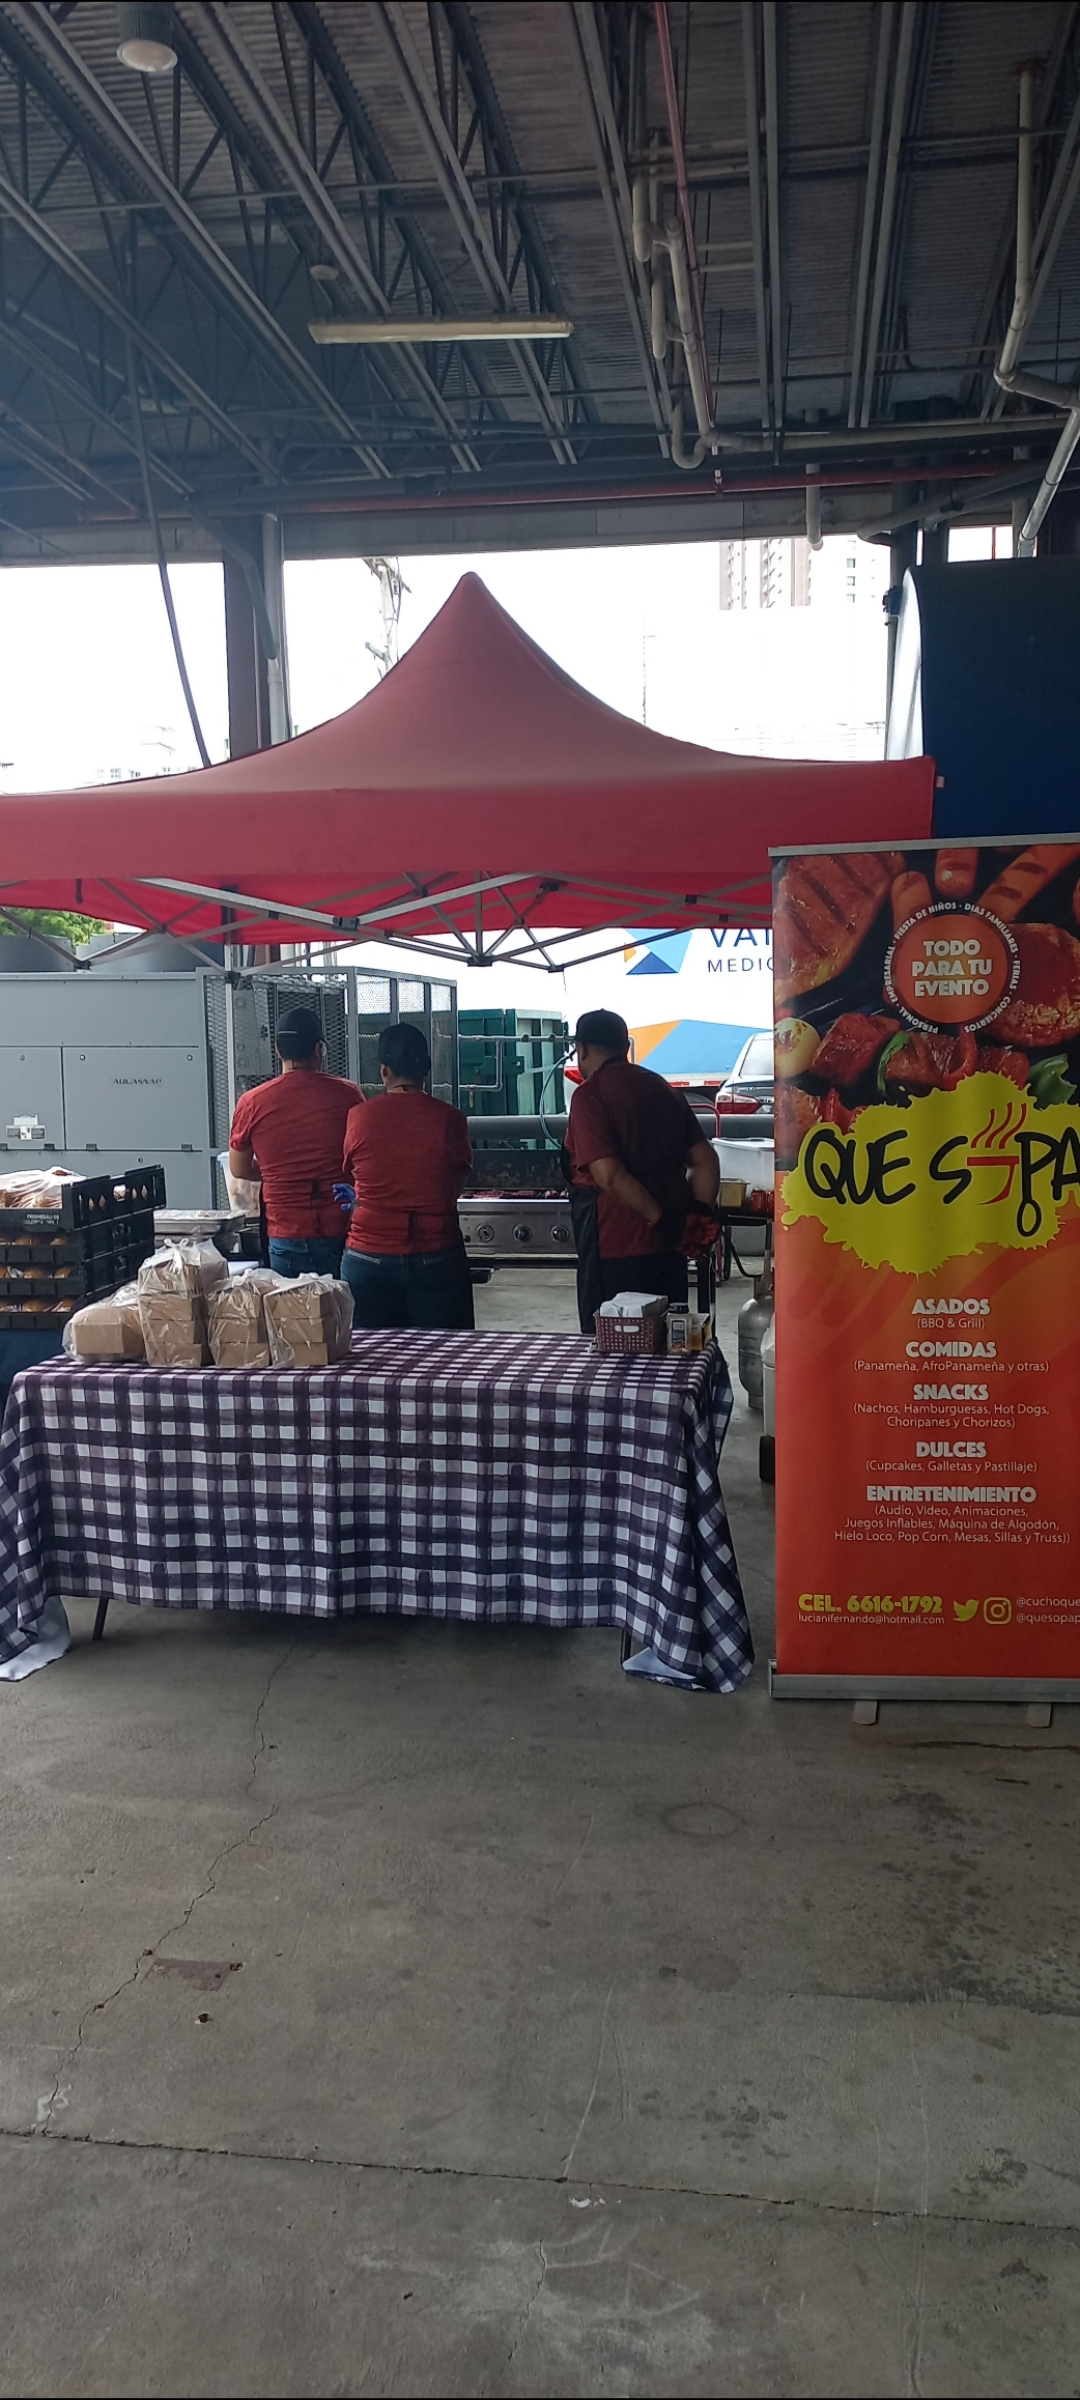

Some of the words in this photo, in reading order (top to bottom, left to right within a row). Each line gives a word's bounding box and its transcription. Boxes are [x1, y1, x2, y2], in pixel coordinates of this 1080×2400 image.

[916, 909, 927, 919] DE
[928, 901, 956, 914] NIÑOS
[964, 903, 985, 915] DIAS
[894, 917, 916, 940] FIESTA
[984, 911, 1019, 953] FAMILIARES
[923, 939, 981, 956] TODO
[884, 946, 898, 1003] EMPRESARIAL
[912, 960, 965, 977] PARA
[968, 959, 992, 975] TU
[1009, 960, 1020, 990] FERIAS
[914, 979, 989, 997] EVENTO
[899, 1006, 938, 1033] PERSONAL
[964, 996, 1011, 1033] CONCIERTOS
[804, 1128, 916, 1205] QUE
[911, 1298, 991, 1315] ASADOS
[917, 1318, 944, 1329] (BBQ
[947, 1318, 955, 1328] &
[958, 1318, 985, 1329] Grill)
[906, 1341, 997, 1358] COMIDAS
[854, 1360, 919, 1372] (Panameña,
[922, 1360, 1005, 1371] AfroPanameña
[1007, 1363, 1014, 1373] y
[1017, 1361, 1049, 1372] otras)
[913, 1384, 989, 1400] SNACKS
[853, 1402, 901, 1414] (Nachos,
[904, 1403, 991, 1416] Hamburguesas,
[994, 1403, 1015, 1414] Hot
[1017, 1403, 1050, 1416] Dogs,
[887, 1416, 950, 1429] Choripanes
[953, 1420, 960, 1429] y
[962, 1416, 1015, 1429] Chorizos)
[916, 1441, 987, 1458] DULCES
[866, 1460, 925, 1473] (Cupcakes,
[928, 1460, 972, 1471] Galletas
[975, 1463, 982, 1474] y
[984, 1461, 1037, 1474] Pastillaje)
[866, 1485, 1037, 1503] ENTRETENIMIENTO
[875, 1504, 914, 1516] (Audio,
[916, 1505, 951, 1516] Video,
[953, 1506, 1029, 1517] Animaciones,
[845, 1517, 883, 1530] Juegos
[886, 1518, 935, 1529] Inflables,
[938, 1519, 987, 1531] Máquina
[990, 1519, 1005, 1529] de
[1008, 1519, 1059, 1531] Algodón,
[834, 1530, 863, 1540] Hielo
[866, 1531, 895, 1542] Loco,
[898, 1531, 919, 1544] Pop
[922, 1531, 952, 1543] Corn,
[954, 1532, 992, 1543] Mesas,
[994, 1532, 1022, 1542] Sillas
[1025, 1534, 1031, 1544] y
[1033, 1532, 1070, 1544] Truss))
[799, 1593, 842, 1612] CEL.
[847, 1595, 943, 1613] 6616-1792
[1016, 1596, 1080, 1609] @cuchoque
[798, 1612, 945, 1624] lucianifernando@hotmail.com
